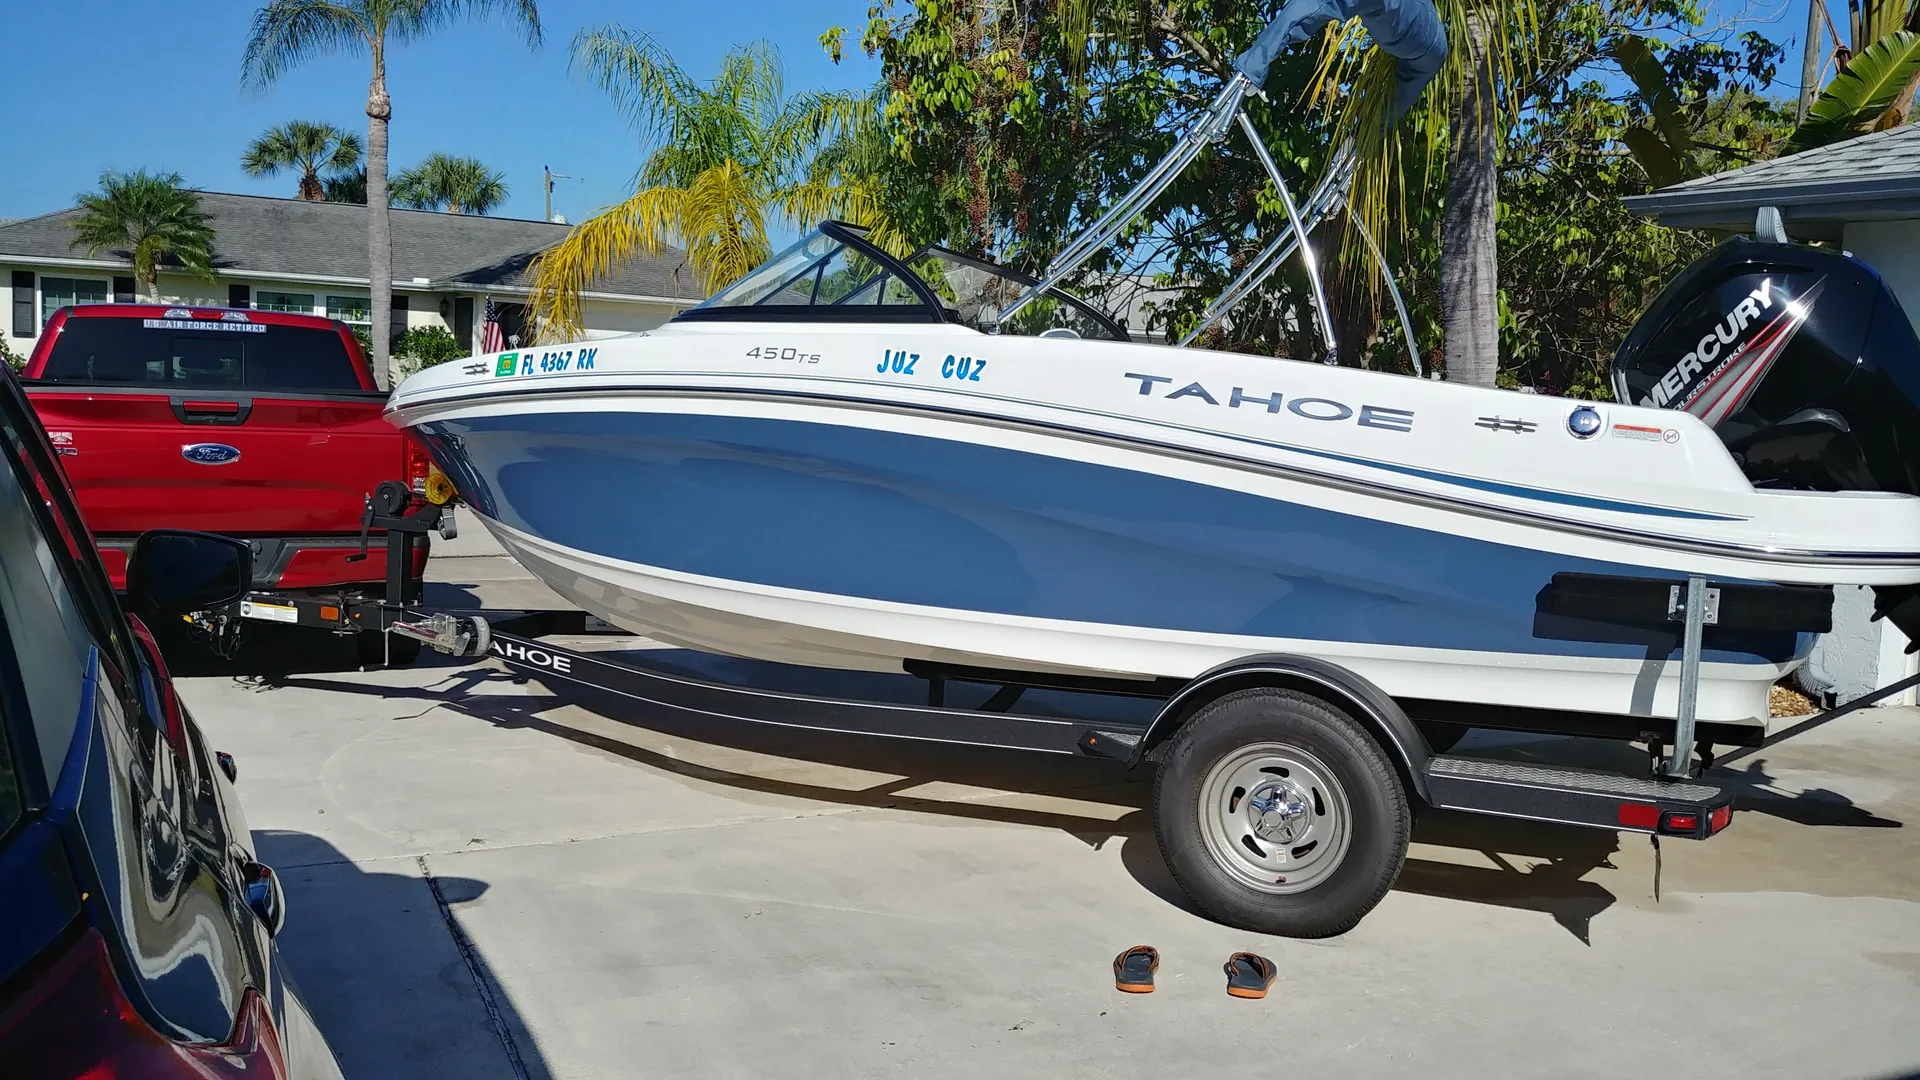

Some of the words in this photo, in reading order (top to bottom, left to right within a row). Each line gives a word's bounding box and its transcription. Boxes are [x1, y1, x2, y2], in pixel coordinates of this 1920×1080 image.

[144, 319, 162, 328] U.S.
[165, 320, 183, 329] AIR
[187, 321, 219, 330] FORCE
[222, 322, 265, 332] RETIRED
[1639, 277, 1771, 408] MERCURY
[521, 354, 534, 376] FL
[540, 350, 573, 373] 4367
[577, 347, 598, 370] RK
[876, 349, 920, 375] JUZ
[941, 354, 987, 381] CUZ
[1672, 331, 1747, 411] OURSTROKE
[1124, 372, 1415, 433] TAHOE
[196, 447, 227, 460] Ford
[487, 640, 571, 673] AHOE
